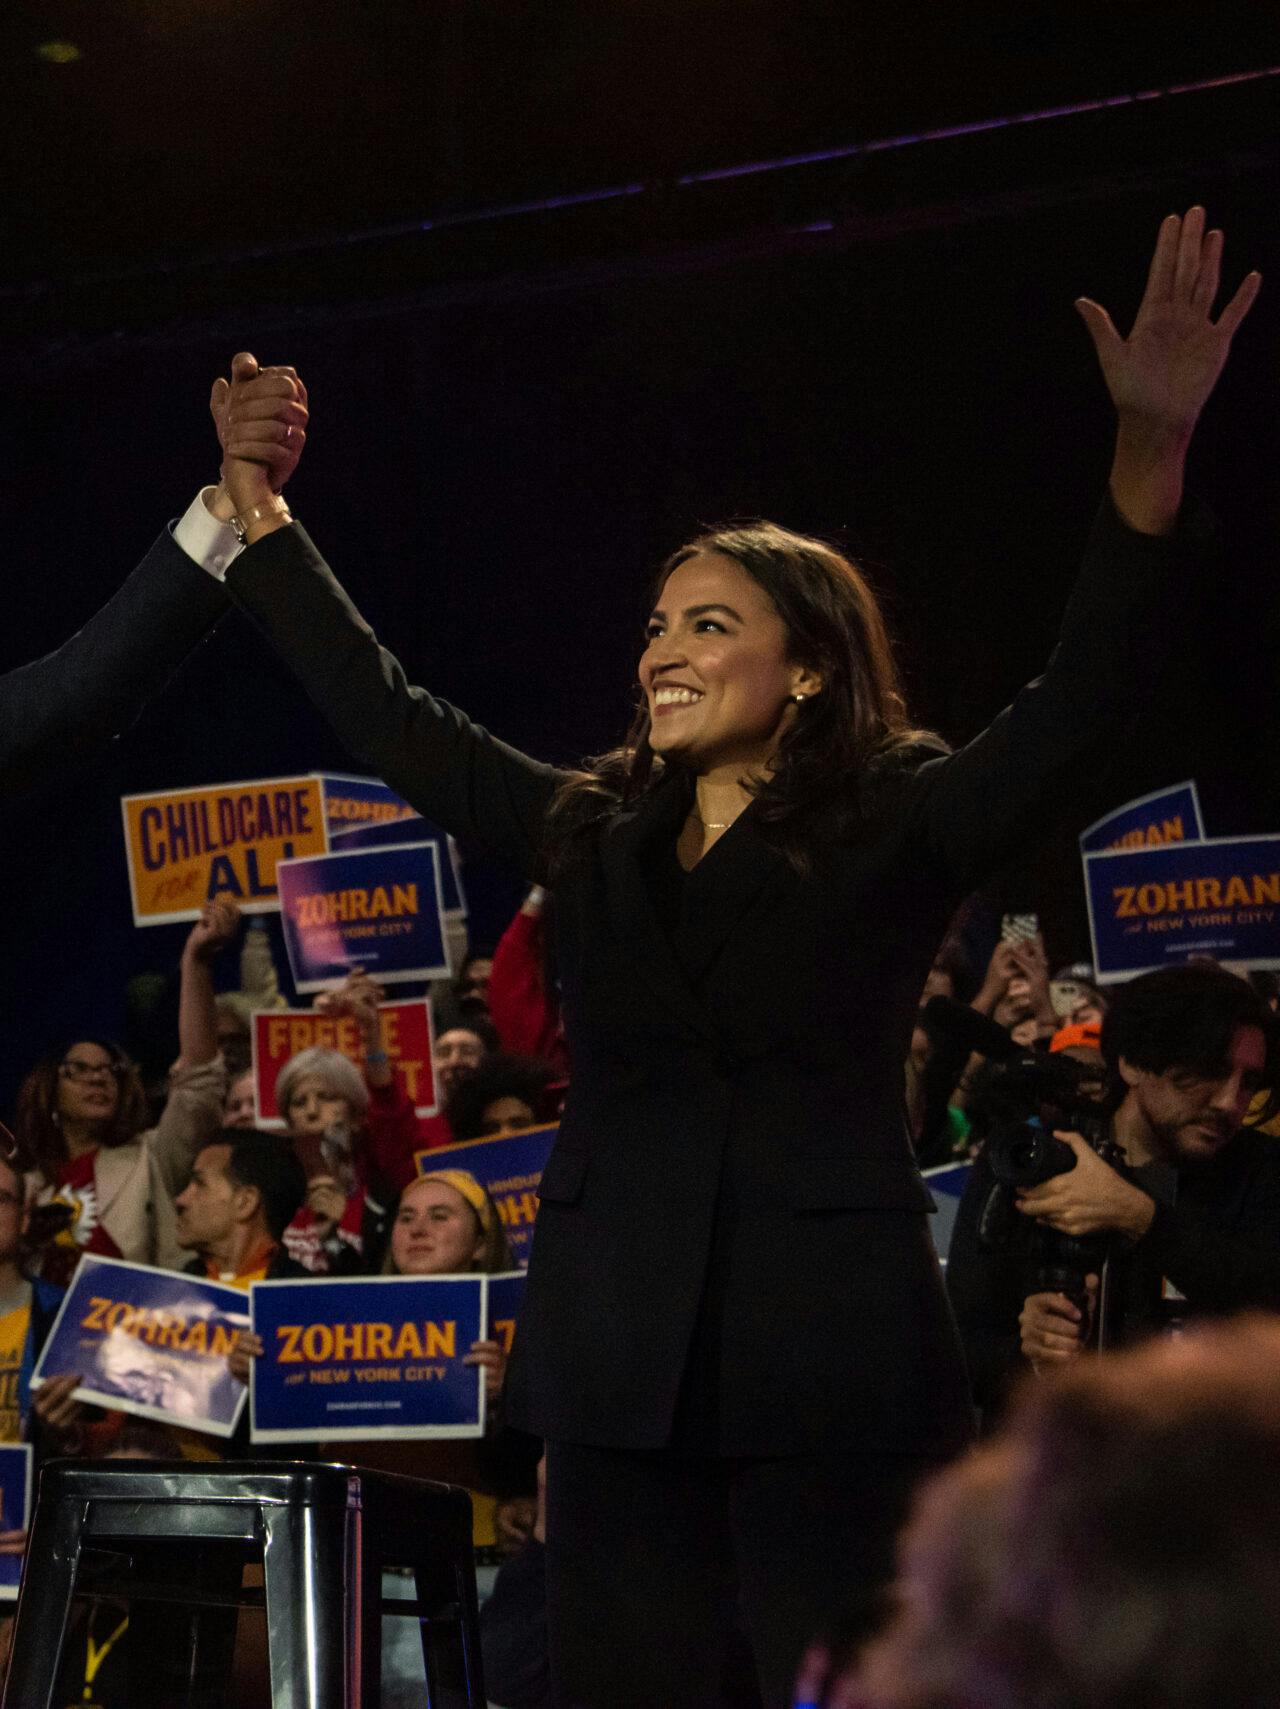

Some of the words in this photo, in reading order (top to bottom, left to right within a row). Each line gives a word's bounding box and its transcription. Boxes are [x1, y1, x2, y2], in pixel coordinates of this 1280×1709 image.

[140, 789, 314, 872] CHILDCARE
[295, 882, 419, 930] ZOHRAN
[1111, 872, 1280, 919] ZOHRAN
[80, 1296, 239, 1356] ZOHRAN
[275, 1319, 457, 1364] ZOHRAN
[309, 1368, 352, 1385] NEW
[354, 1366, 402, 1384] YORK
[404, 1365, 448, 1382] CITY
